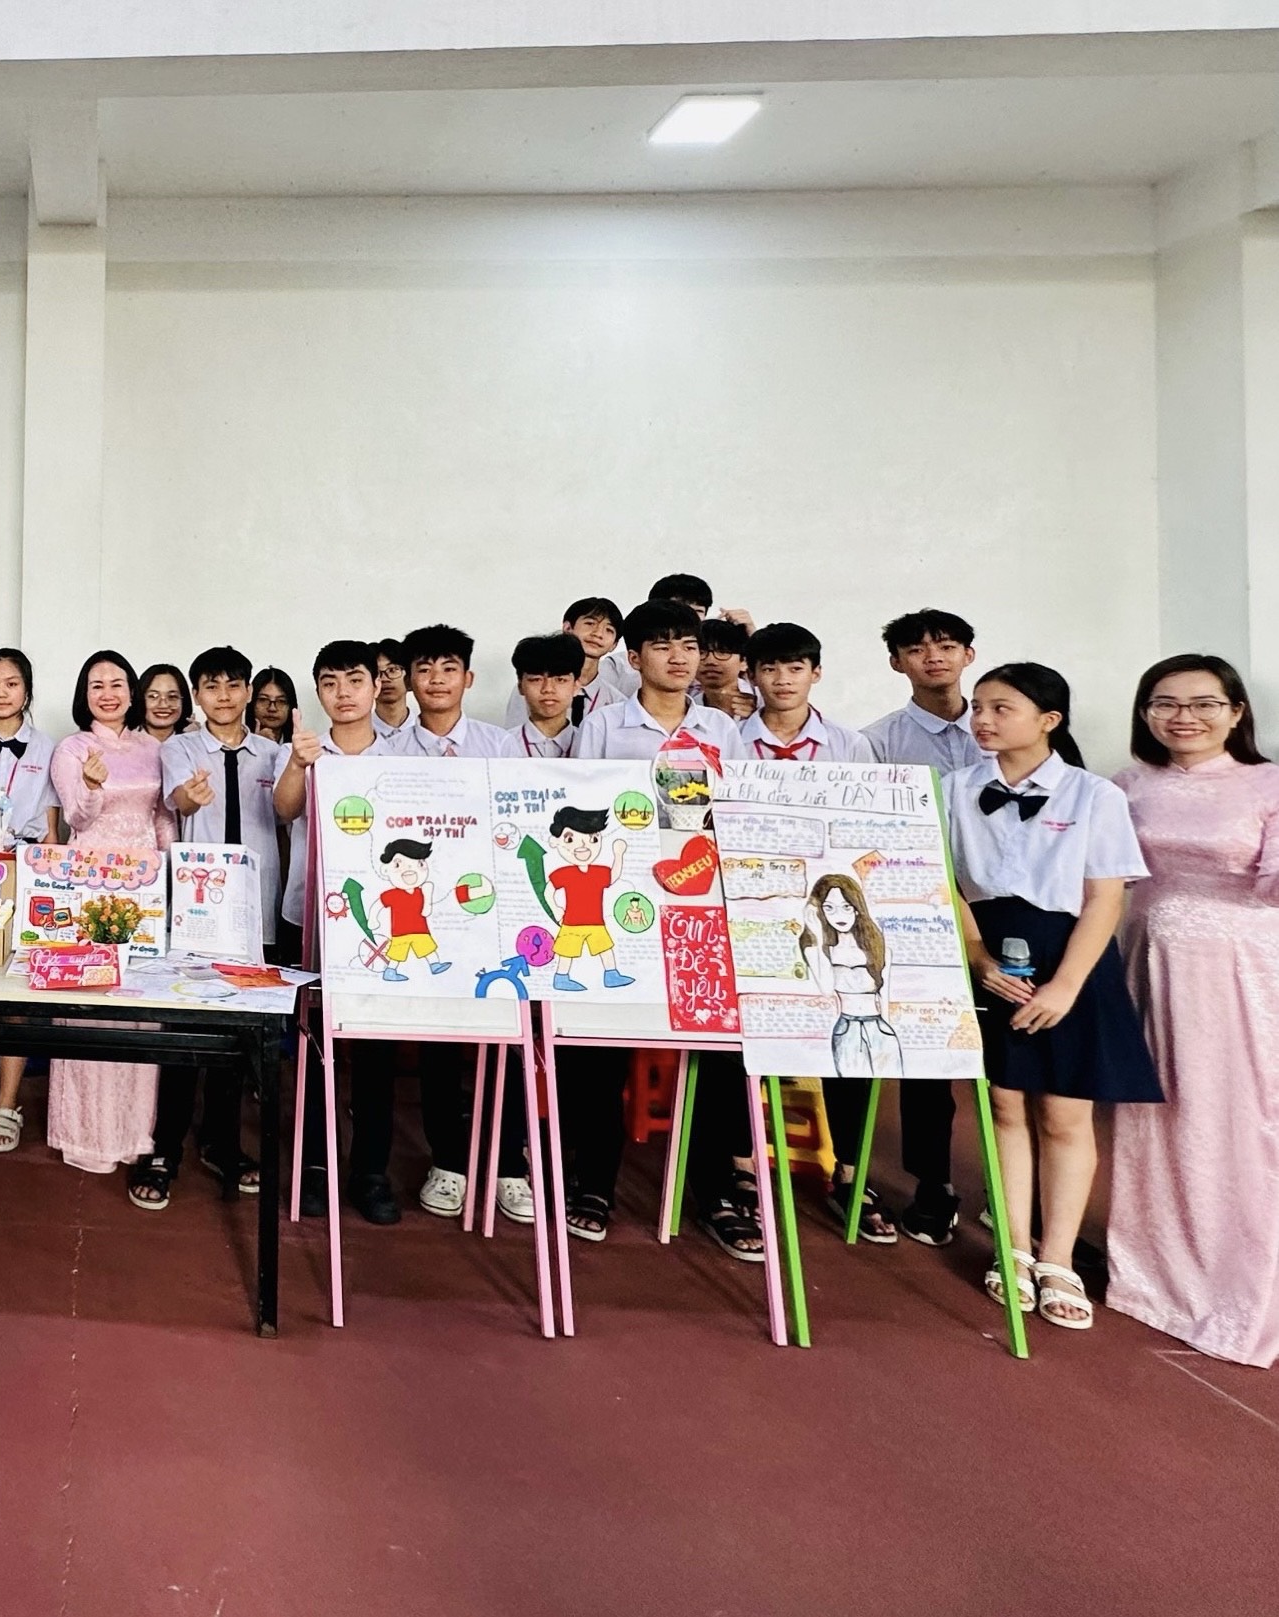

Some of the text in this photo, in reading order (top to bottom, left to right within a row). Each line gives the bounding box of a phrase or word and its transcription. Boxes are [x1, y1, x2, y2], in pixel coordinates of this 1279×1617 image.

[494, 791, 519, 803] CON
[521, 788, 549, 801] TRAI
[386, 814, 478, 828] CON TRAI CHƯA
[423, 825, 465, 839] DẬY THÌ
[32, 847, 62, 863] Biện
[180, 849, 215, 864] VÒNG
